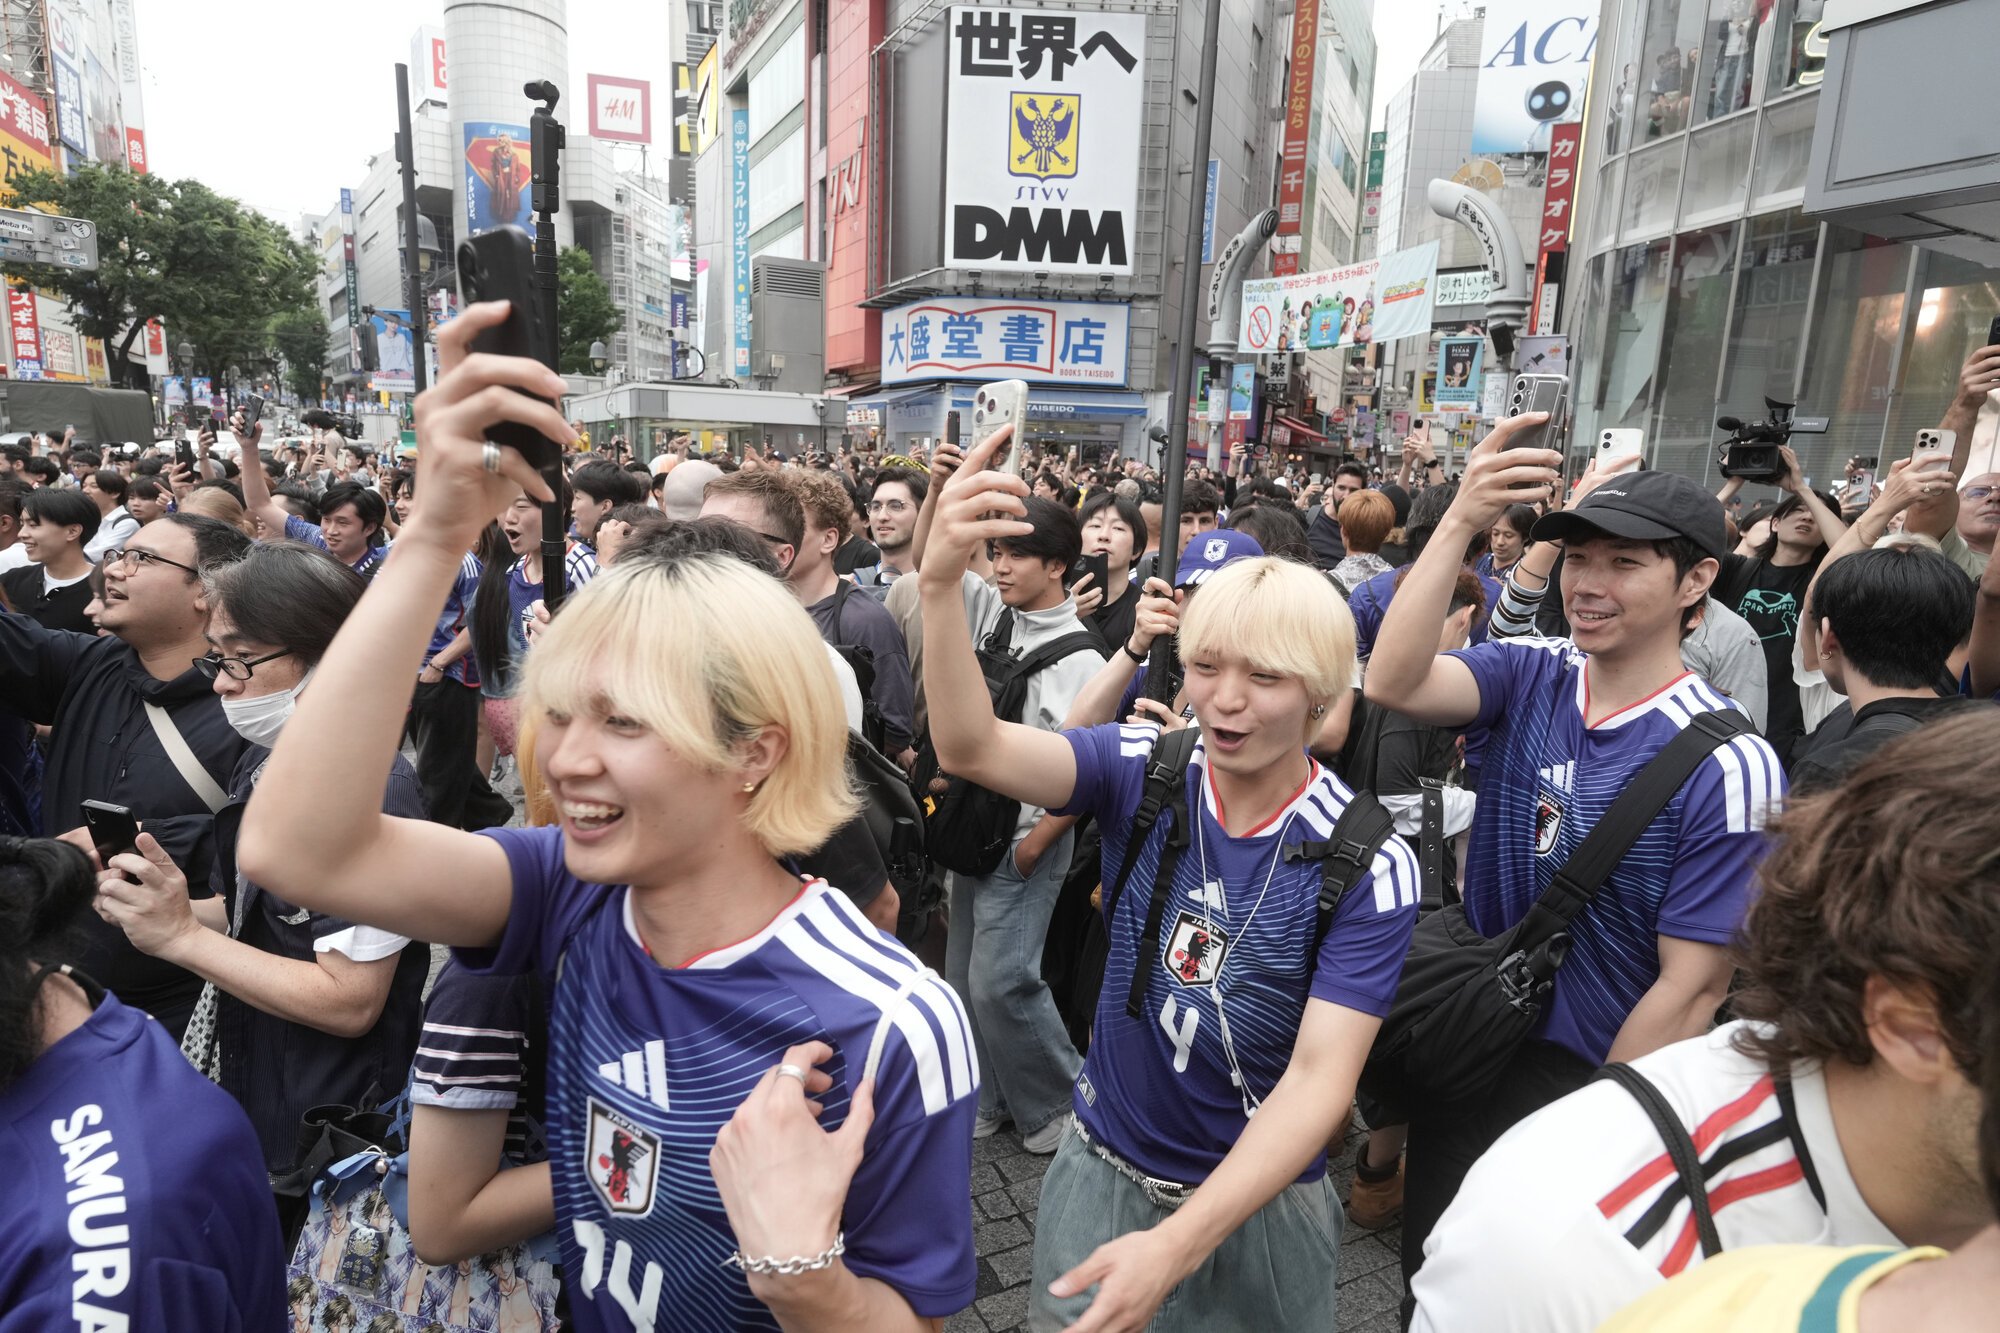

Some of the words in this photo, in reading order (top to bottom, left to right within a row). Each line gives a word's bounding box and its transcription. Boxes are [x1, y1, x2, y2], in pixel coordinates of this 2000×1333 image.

[955, 11, 1138, 82] 世界へ
[604, 96, 636, 120] H&M
[1015, 185, 1069, 203] STVV
[1280, 141, 1305, 223] 三千里
[1541, 138, 1575, 247] カラオケ
[733, 139, 748, 280] サマーフルーツギフト
[953, 204, 1128, 267] DMM
[1462, 202, 1500, 284] 渋谷センター街
[1209, 238, 1240, 317] 渋谷センター街
[1452, 277, 1491, 288] れいわ
[1438, 290, 1490, 303] クリニック
[11, 291, 37, 358] スギ薬局
[676, 302, 684, 328] MIZU
[888, 312, 1106, 367] 大盛堂書店
[1059, 368, 1081, 377] BOOKS
[1084, 369, 1114, 379] TAISEIDO
[1026, 404, 1075, 413] TAISEIDO
[1744, 600, 1763, 614] PAR
[1767, 603, 1794, 614] STORY
[1539, 794, 1558, 809] JAPAN
[1191, 918, 1220, 936] JAPAN
[1176, 962, 1201, 980] JFA
[606, 1111, 643, 1138] JAPAN
[602, 1173, 631, 1204] JFA
